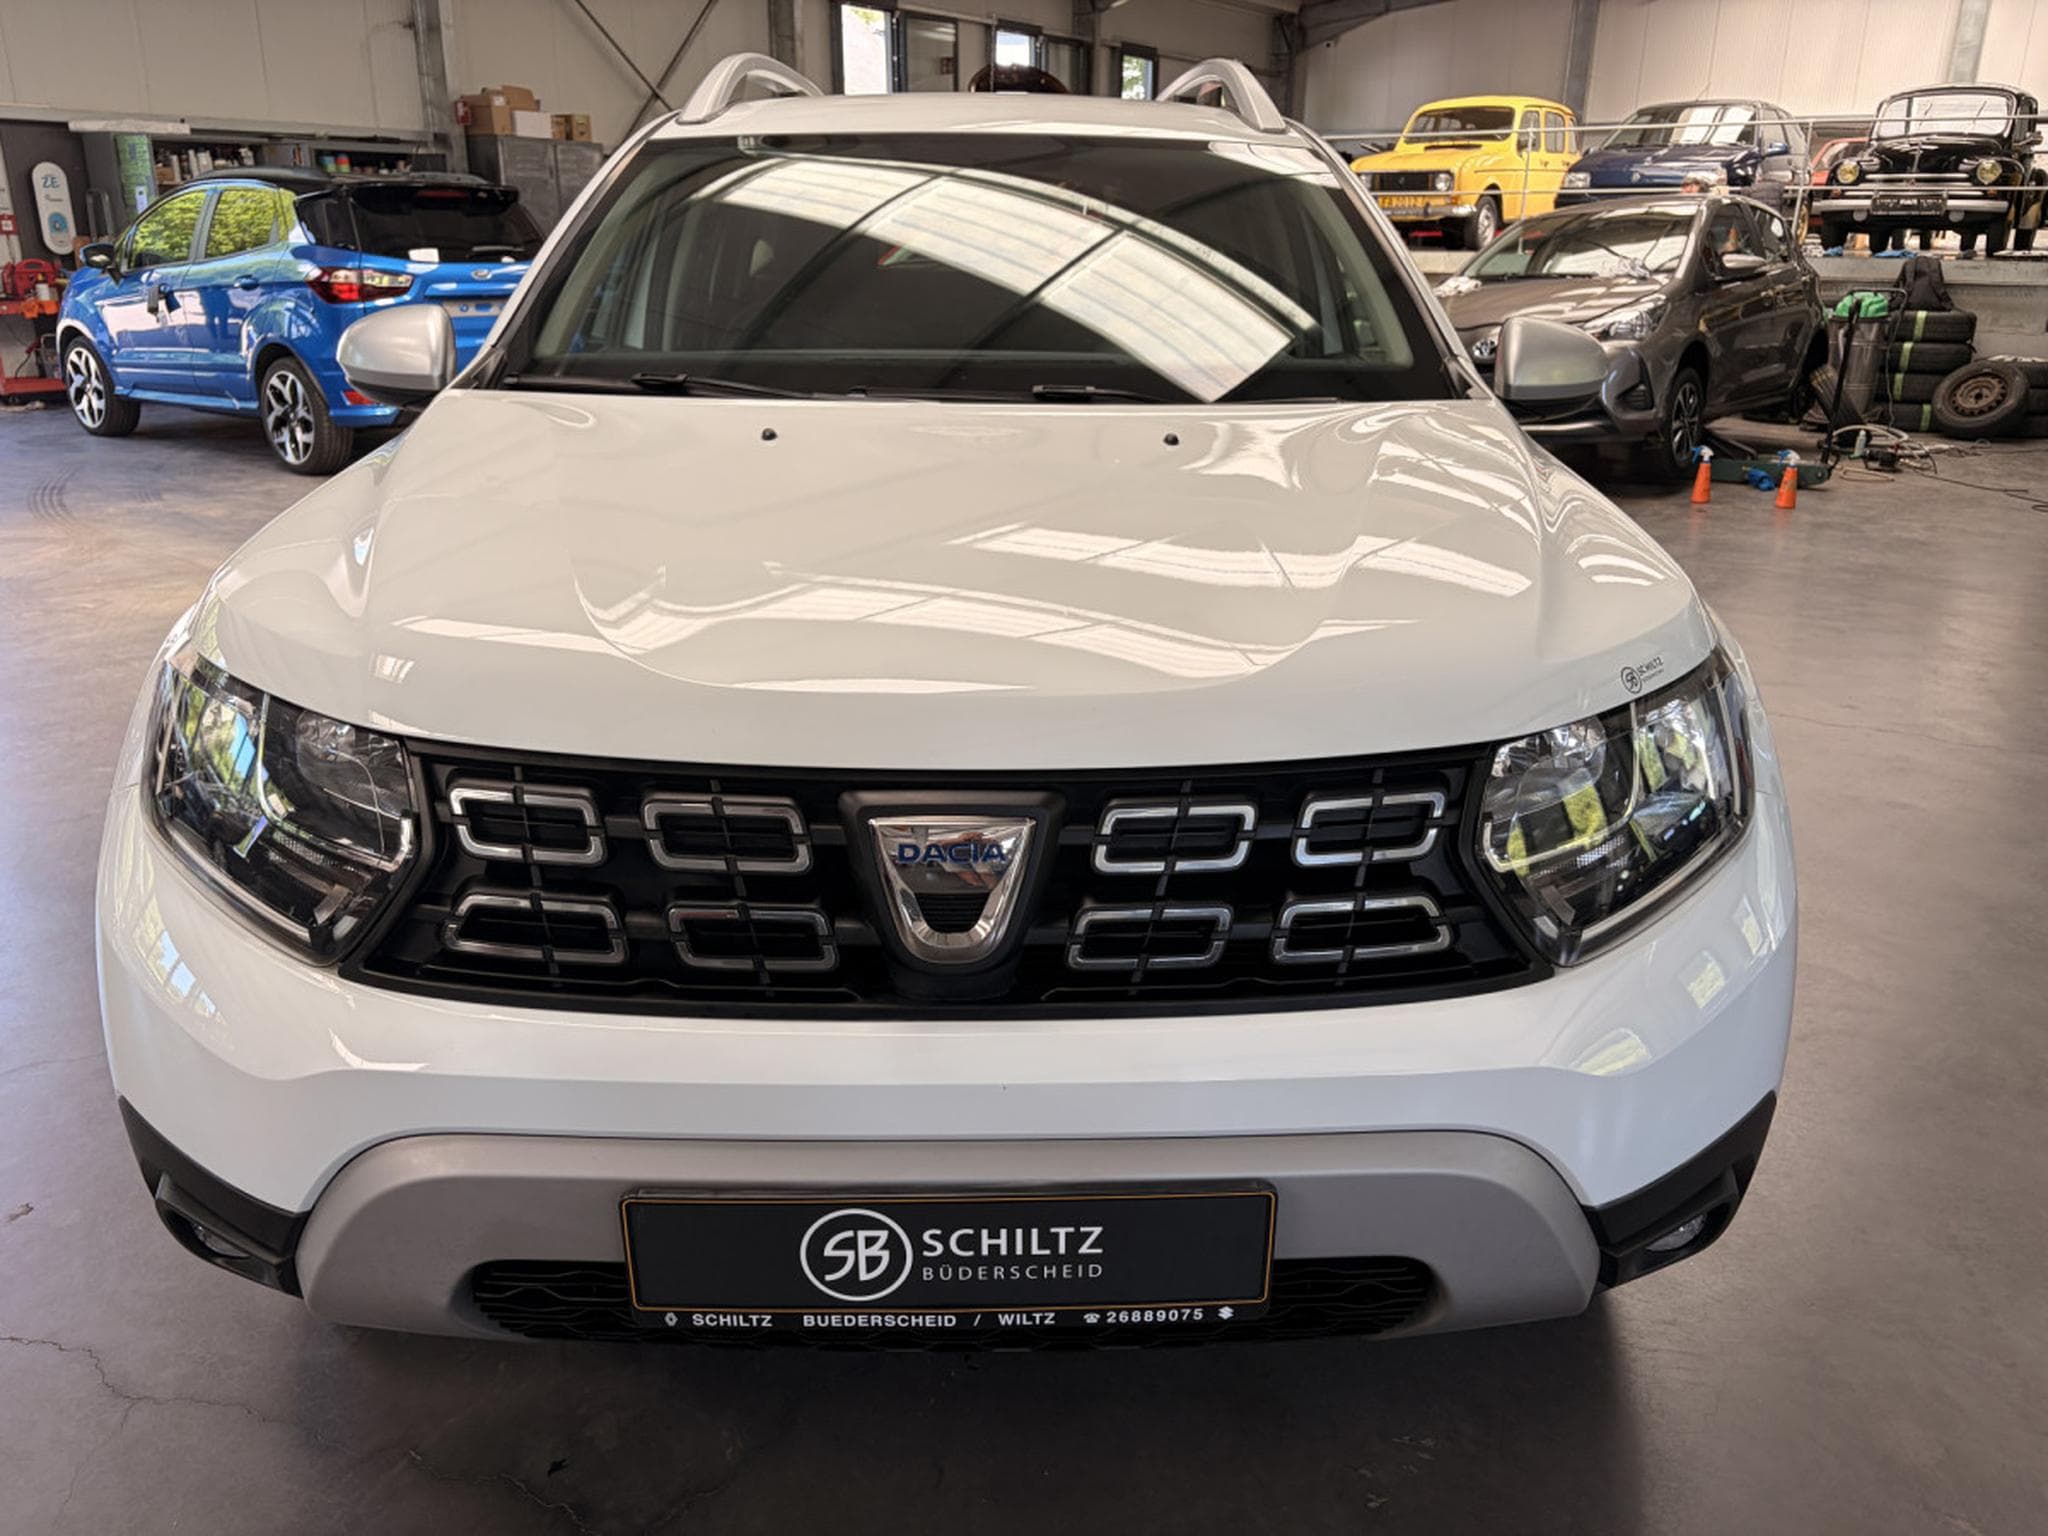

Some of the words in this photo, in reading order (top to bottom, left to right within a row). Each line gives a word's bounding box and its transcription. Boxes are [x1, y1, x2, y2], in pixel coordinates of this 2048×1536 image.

[898, 843, 1006, 863] DACIA
[922, 1226, 1104, 1257] SCHILTZ
[922, 1263, 1104, 1282] BÜDERSCHEID
[691, 1313, 773, 1327] SCHILTZ
[802, 1314, 957, 1328] BUEDERSCHEID
[997, 1312, 1056, 1326] WILTZ
[1105, 1308, 1204, 1324] 26889075
